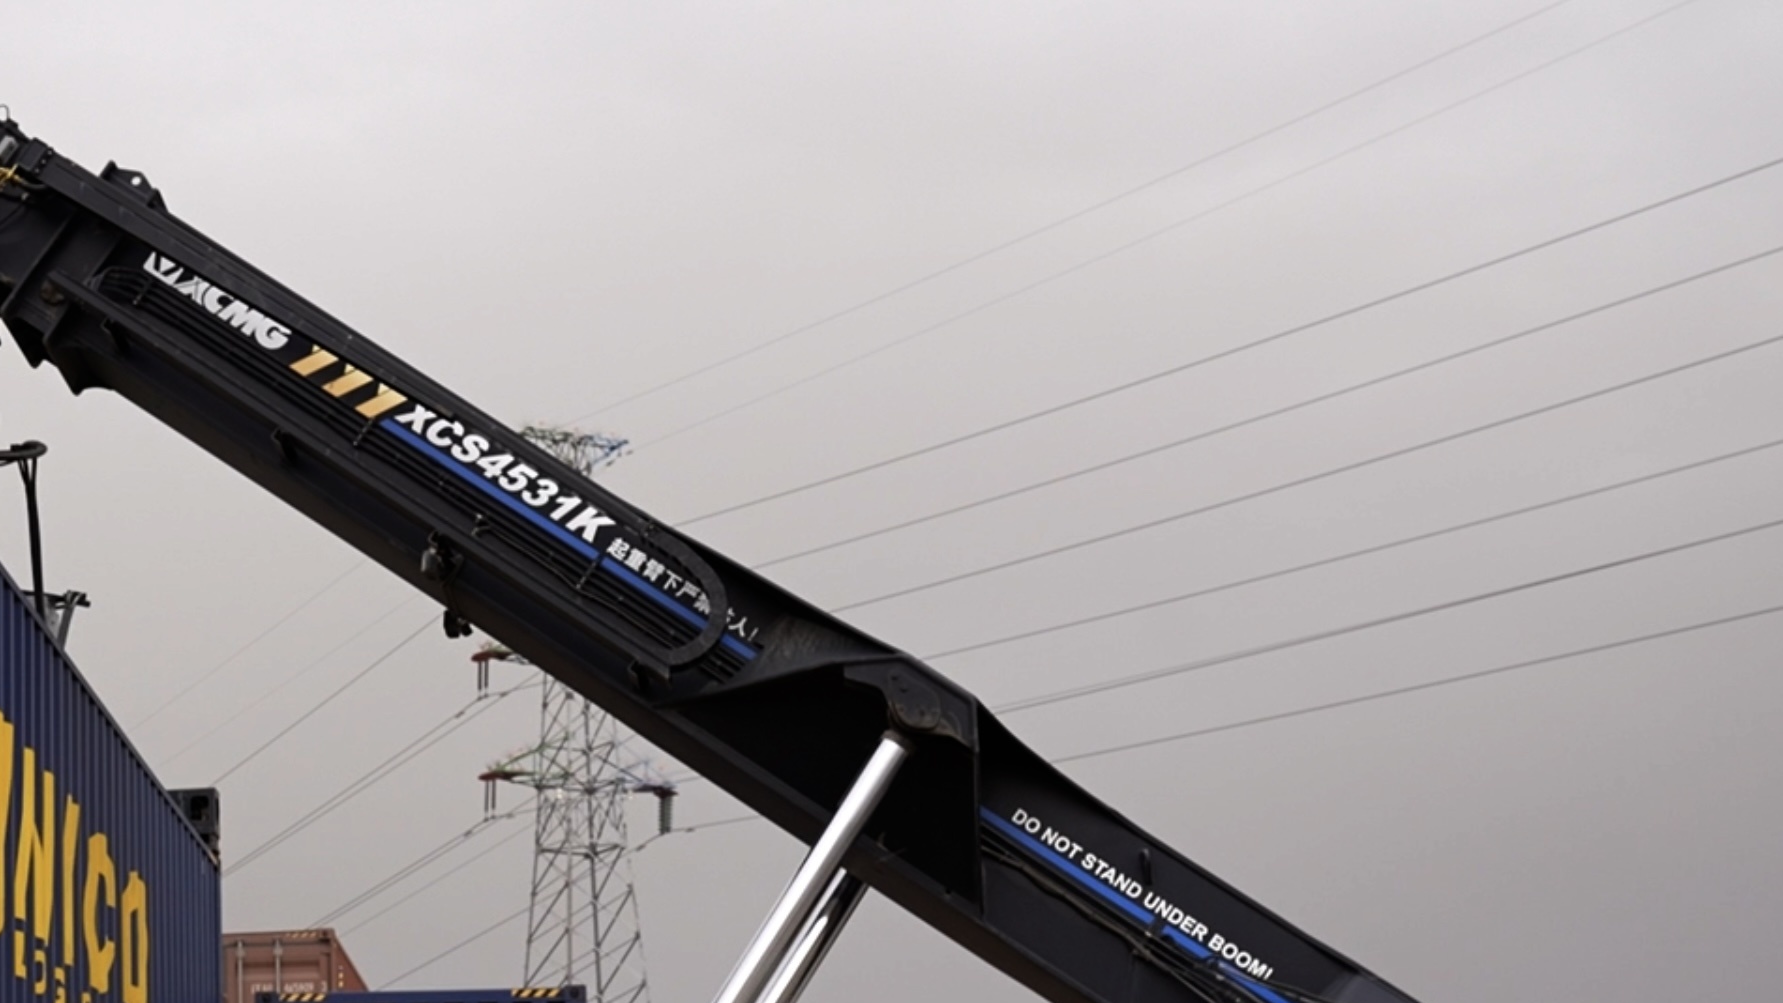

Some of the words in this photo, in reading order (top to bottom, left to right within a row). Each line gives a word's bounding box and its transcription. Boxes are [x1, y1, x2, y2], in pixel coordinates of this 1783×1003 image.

[174, 275, 293, 350] XCMG
[394, 403, 617, 543] XCS4531K
[1011, 808, 1042, 834] DO
[1040, 827, 1083, 859] NOT
[1081, 852, 1142, 899] STAND
[1143, 891, 1209, 943] UNDER
[1207, 933, 1274, 981] BOOM!
